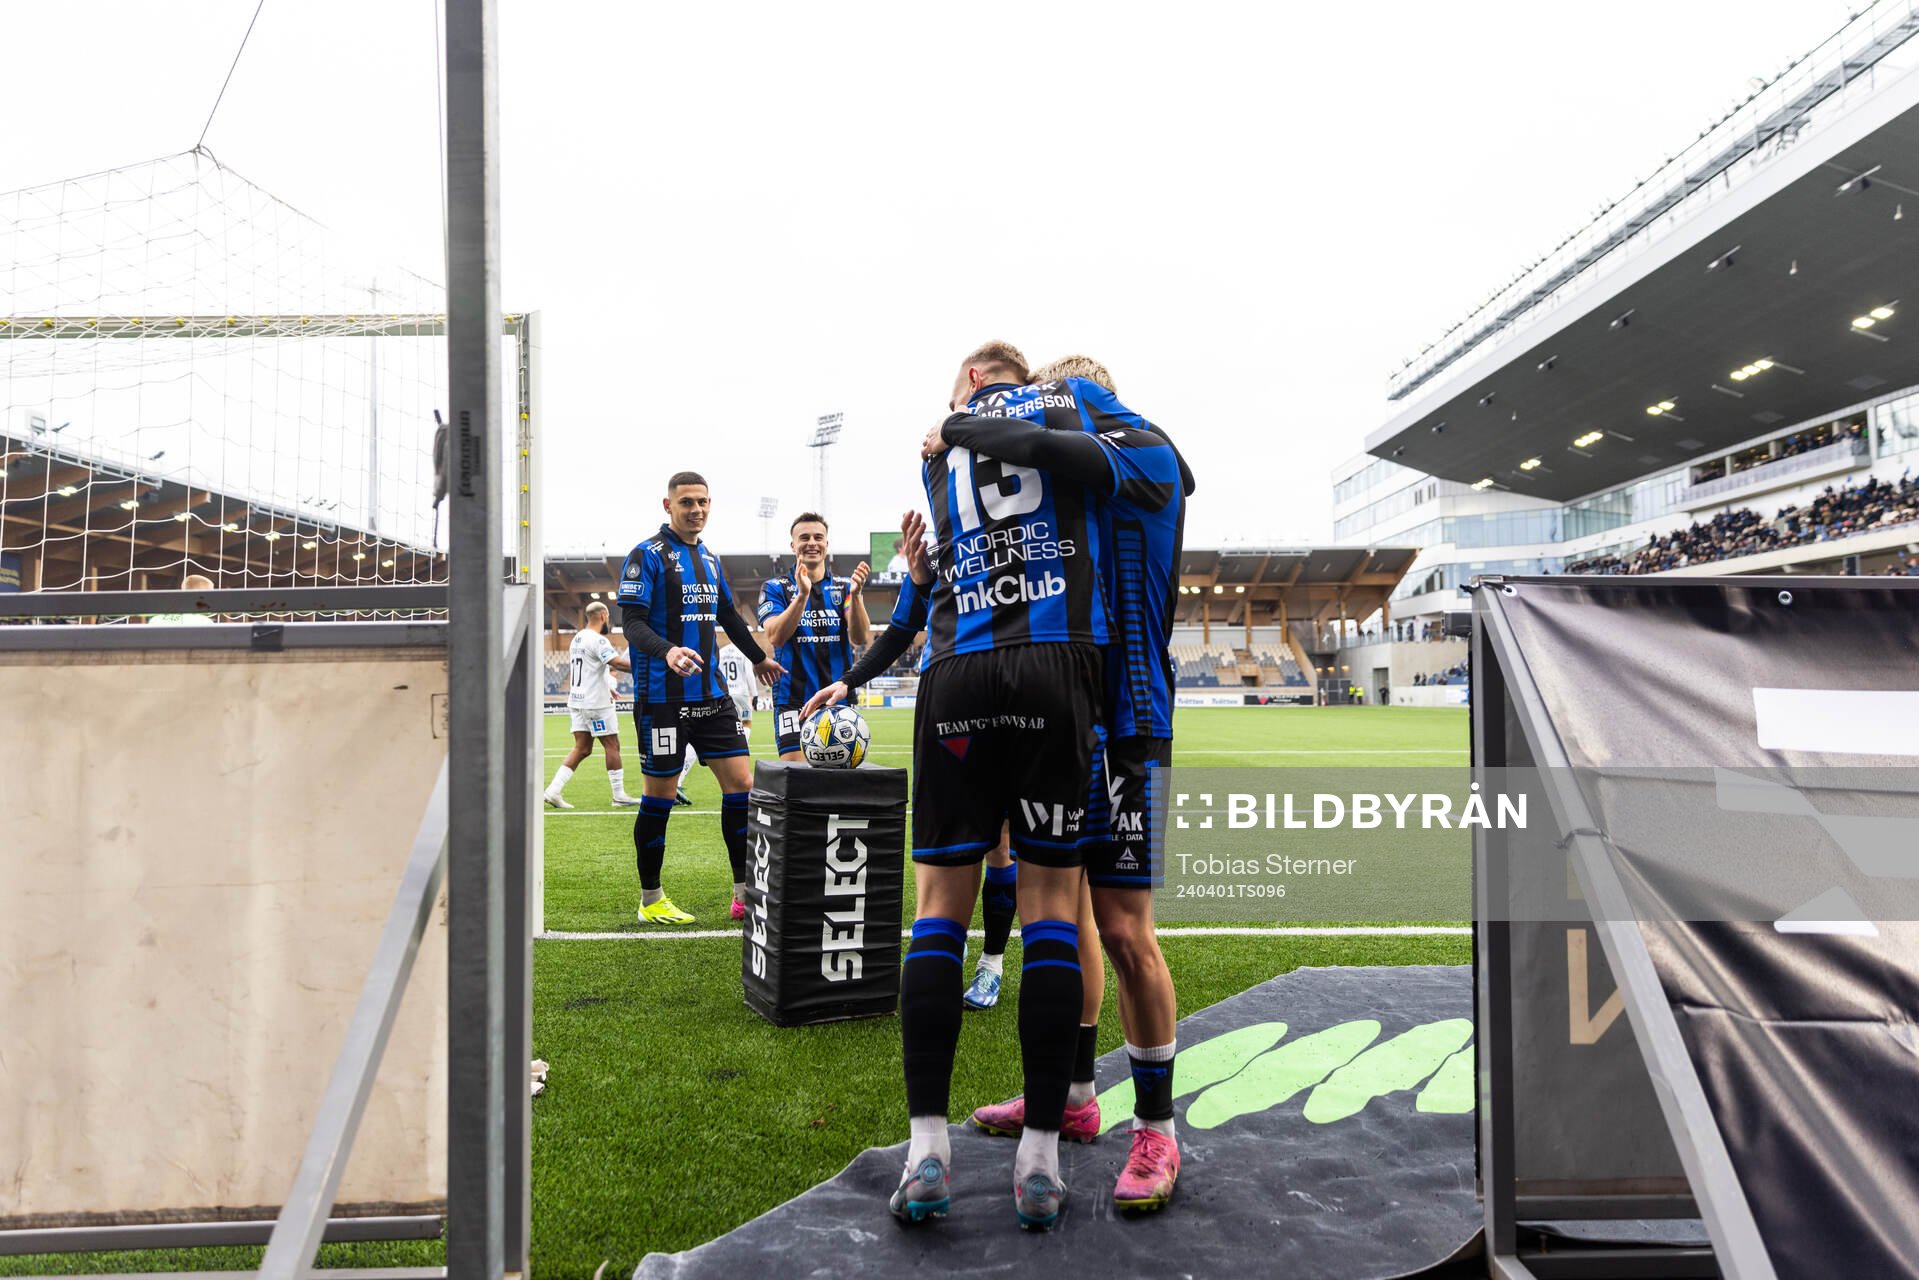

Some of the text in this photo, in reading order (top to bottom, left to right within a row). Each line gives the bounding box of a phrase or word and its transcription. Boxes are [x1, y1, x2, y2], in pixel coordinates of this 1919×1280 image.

[1005, 394, 1077, 418] PERSSON
[946, 445, 1043, 533] 13
[957, 521, 1049, 560] NORDIC
[944, 539, 1076, 583] WELLNESS
[681, 584, 702, 594] BYGG
[952, 570, 1067, 615] inkClub
[680, 614, 703, 622] TOYO
[571, 657, 583, 687] 17
[723, 661, 738, 680] 19
[936, 719, 971, 736] TEAM
[1027, 717, 1045, 729] AB
[809, 749, 845, 761] SELECT
[1115, 862, 1140, 870] SELECT
[750, 807, 772, 981] SELECT
[821, 813, 870, 983] SELECT
